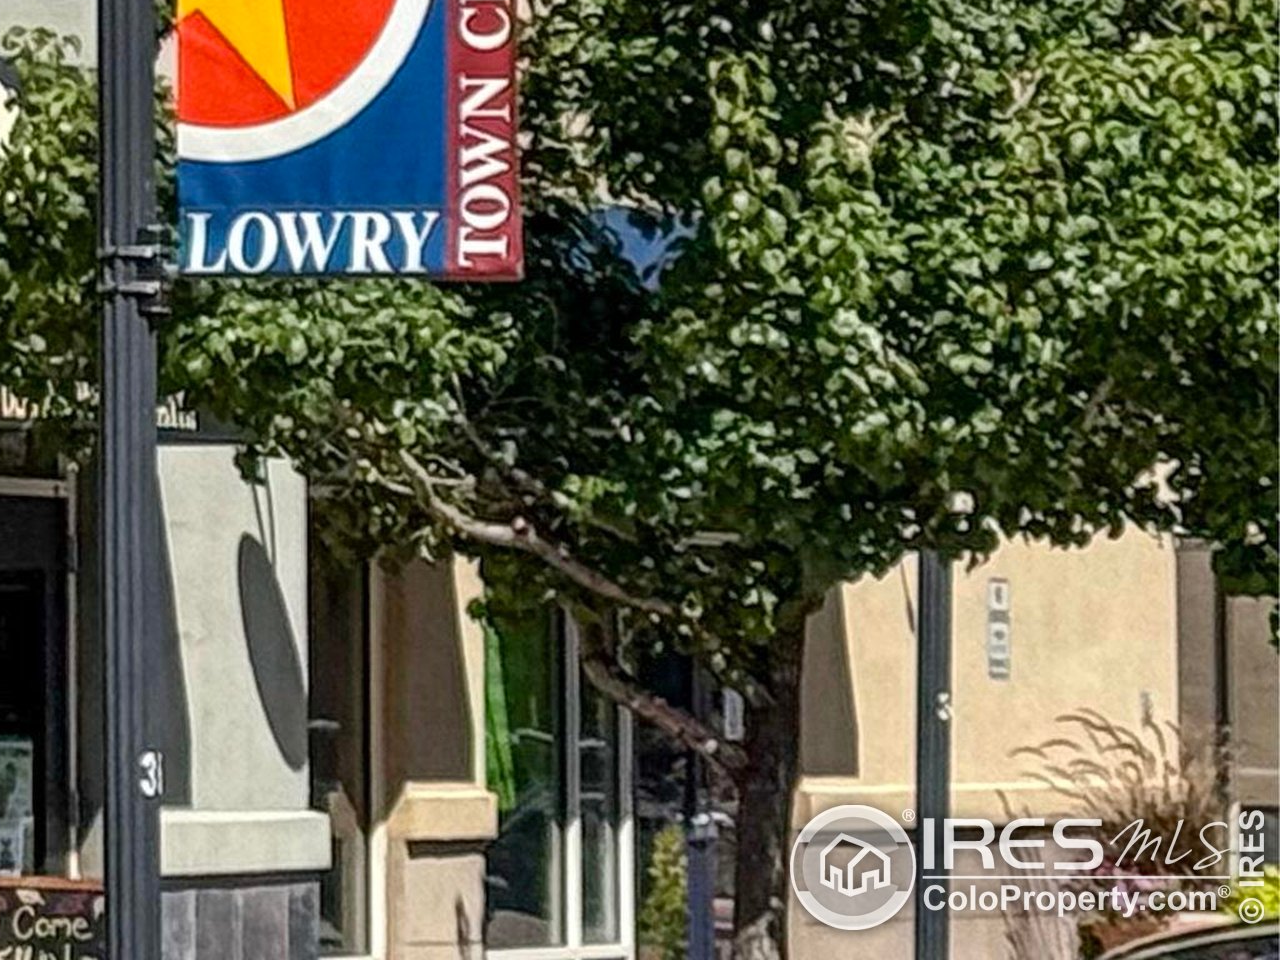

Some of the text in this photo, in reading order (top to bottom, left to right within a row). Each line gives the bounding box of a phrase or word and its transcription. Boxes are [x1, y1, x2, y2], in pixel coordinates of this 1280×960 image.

[459, 76, 512, 268] TOWN
[184, 211, 441, 275] LOWRY
[12, 904, 94, 940] Come
